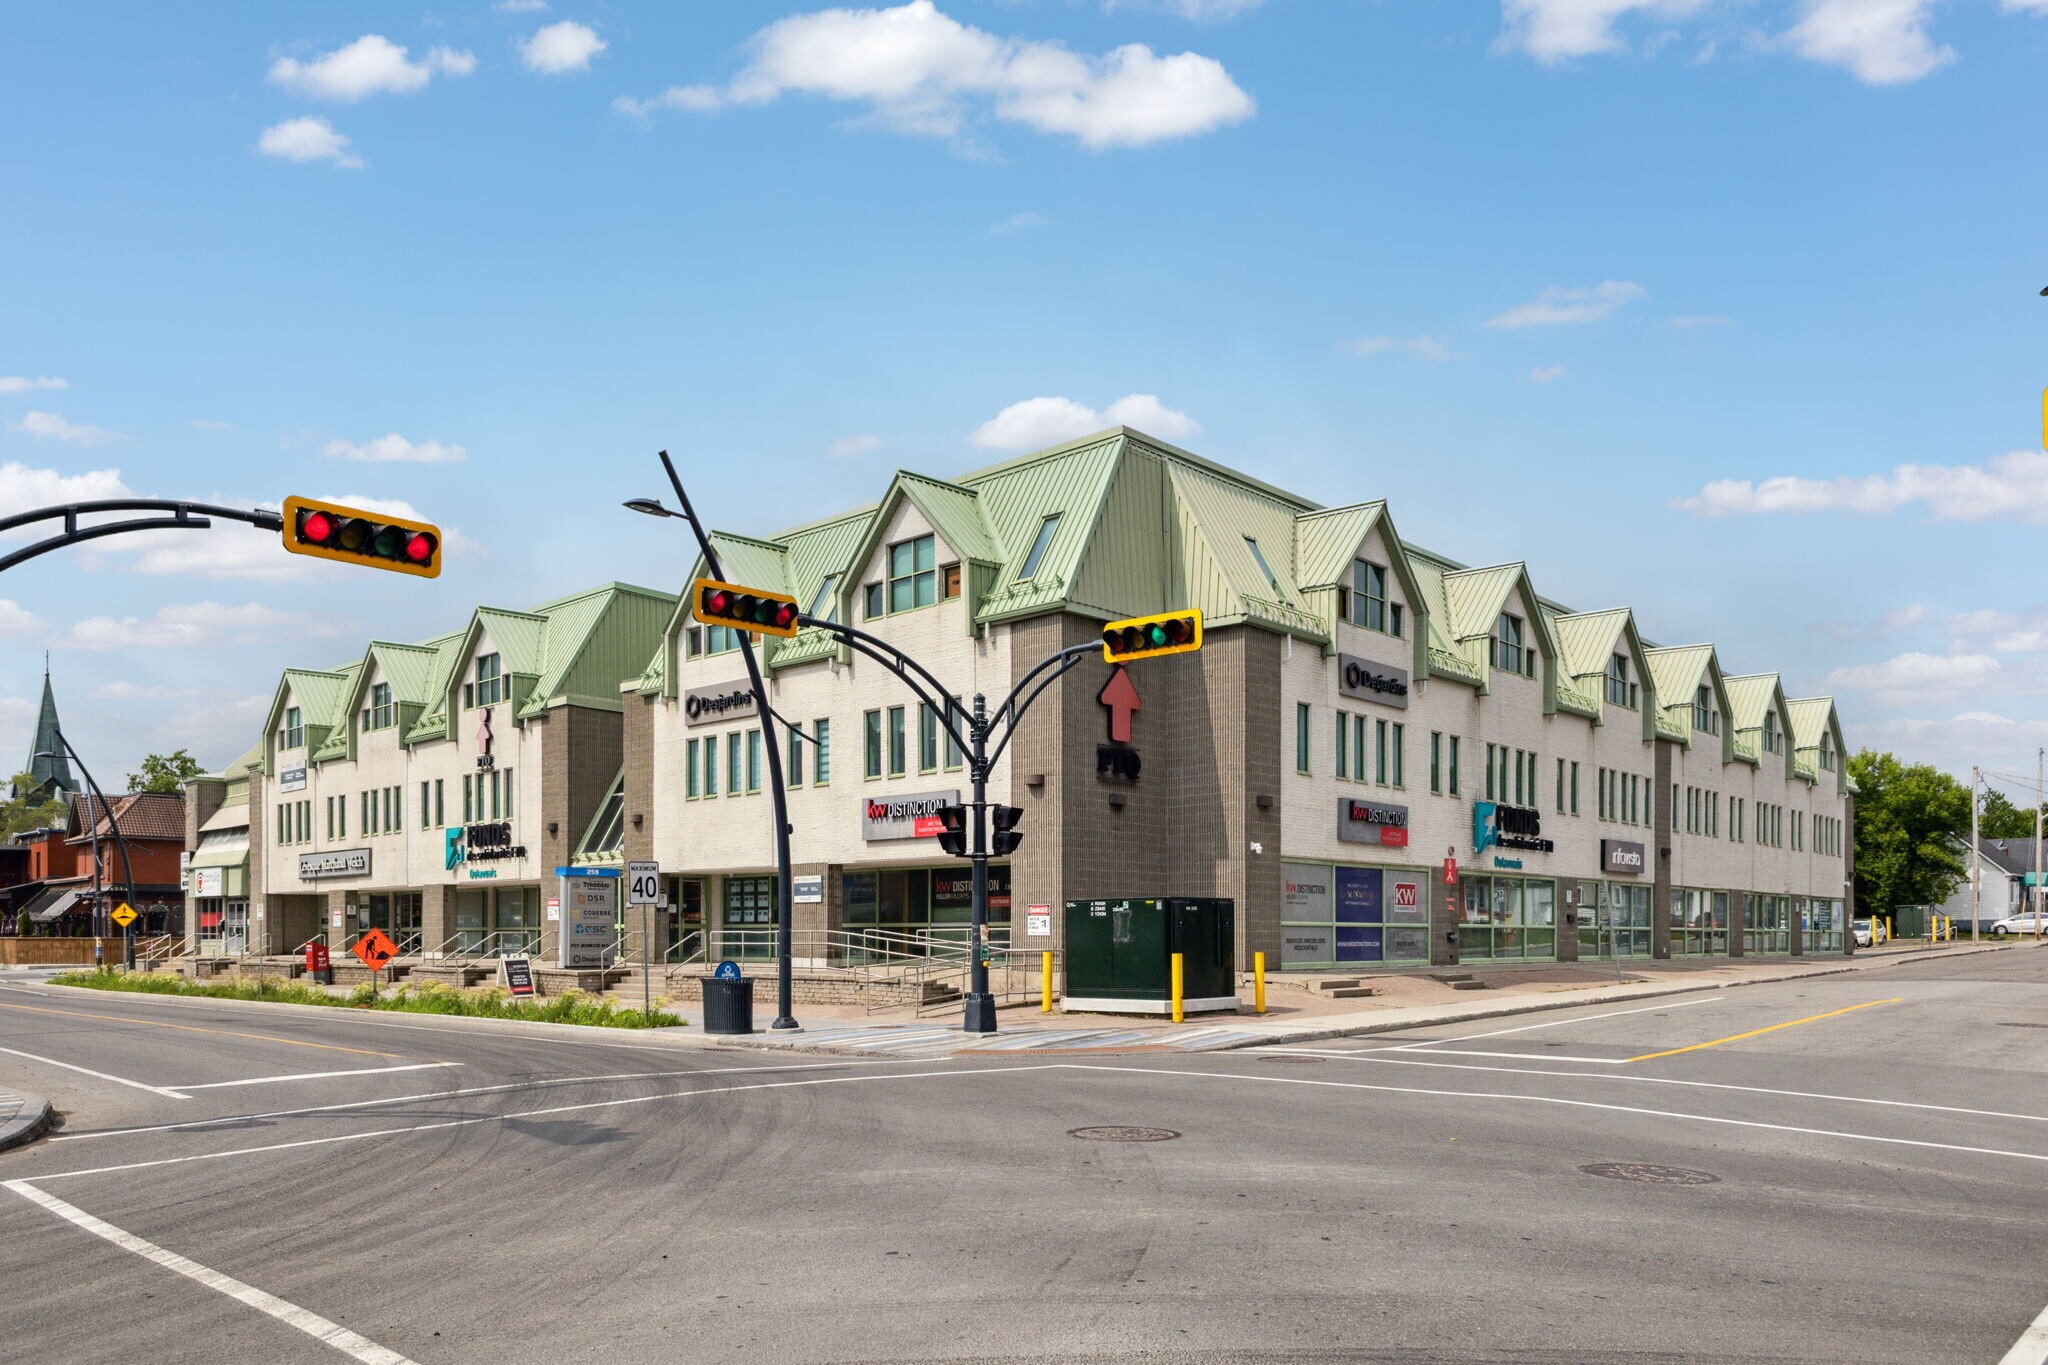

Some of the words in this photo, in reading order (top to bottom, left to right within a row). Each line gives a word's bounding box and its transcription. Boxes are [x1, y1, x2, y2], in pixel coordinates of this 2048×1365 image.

[1361, 670, 1407, 696] Desjardins
[700, 691, 752, 713] Desjardins
[868, 799, 887, 818] kw
[888, 798, 943, 817] DISTINCTION
[1353, 801, 1368, 821] kw
[1368, 808, 1406, 825] DISTINCTION
[1496, 804, 1540, 836] FONDS
[467, 822, 511, 847] FONDS
[1612, 848, 1640, 866] infovista
[632, 876, 657, 898] 40
[953, 880, 999, 892] DISTION
[1297, 884, 1325, 895] DISTINCTION
[1395, 888, 1415, 905] KW
[1029, 906, 1048, 914] DANGER
